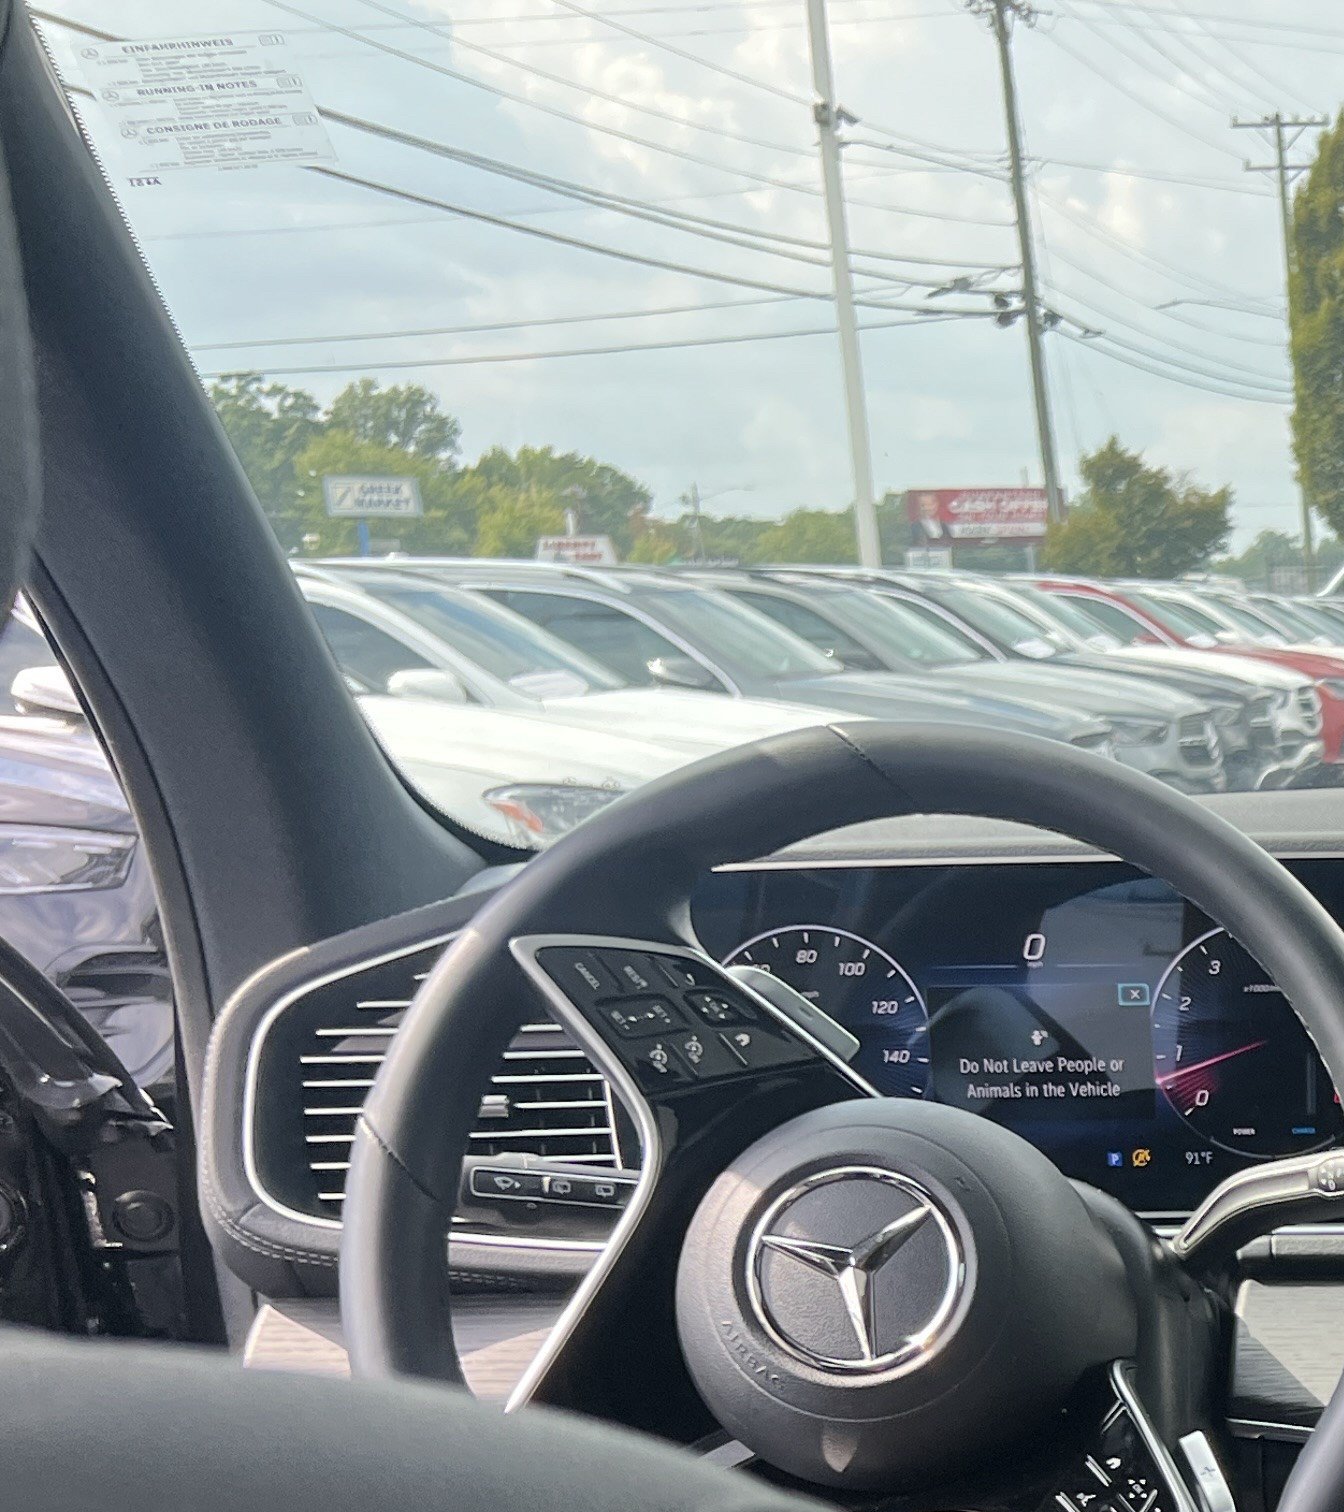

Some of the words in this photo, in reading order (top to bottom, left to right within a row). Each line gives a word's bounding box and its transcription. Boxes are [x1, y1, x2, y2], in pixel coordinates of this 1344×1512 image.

[217, 80, 258, 90] NOTES
[146, 123, 211, 134] CONSIGNE
[214, 120, 230, 129] DE
[232, 117, 282, 127] RODAGE
[1023, 933, 1046, 960] 0
[795, 950, 818, 964] 80
[838, 962, 866, 976] 100
[1208, 960, 1222, 975] 3
[872, 1001, 898, 1014] 120
[1179, 996, 1191, 1011] 2
[883, 1050, 911, 1063] 140
[1176, 1045, 1183, 1062] 1
[959, 1059, 979, 1073] Do
[984, 1058, 1008, 1073] Not
[1013, 1058, 1053, 1073] Leave
[1057, 1057, 1106, 1075] People
[1110, 1059, 1125, 1072] or
[967, 1083, 1022, 1098] Animals
[1025, 1083, 1039, 1097] in
[1042, 1082, 1066, 1097] the
[1071, 1082, 1121, 1097] Vehicle
[1195, 1090, 1209, 1106] 0
[1185, 1151, 1213, 1165] 91°F
[721, 1320, 785, 1391] AIRBAG
